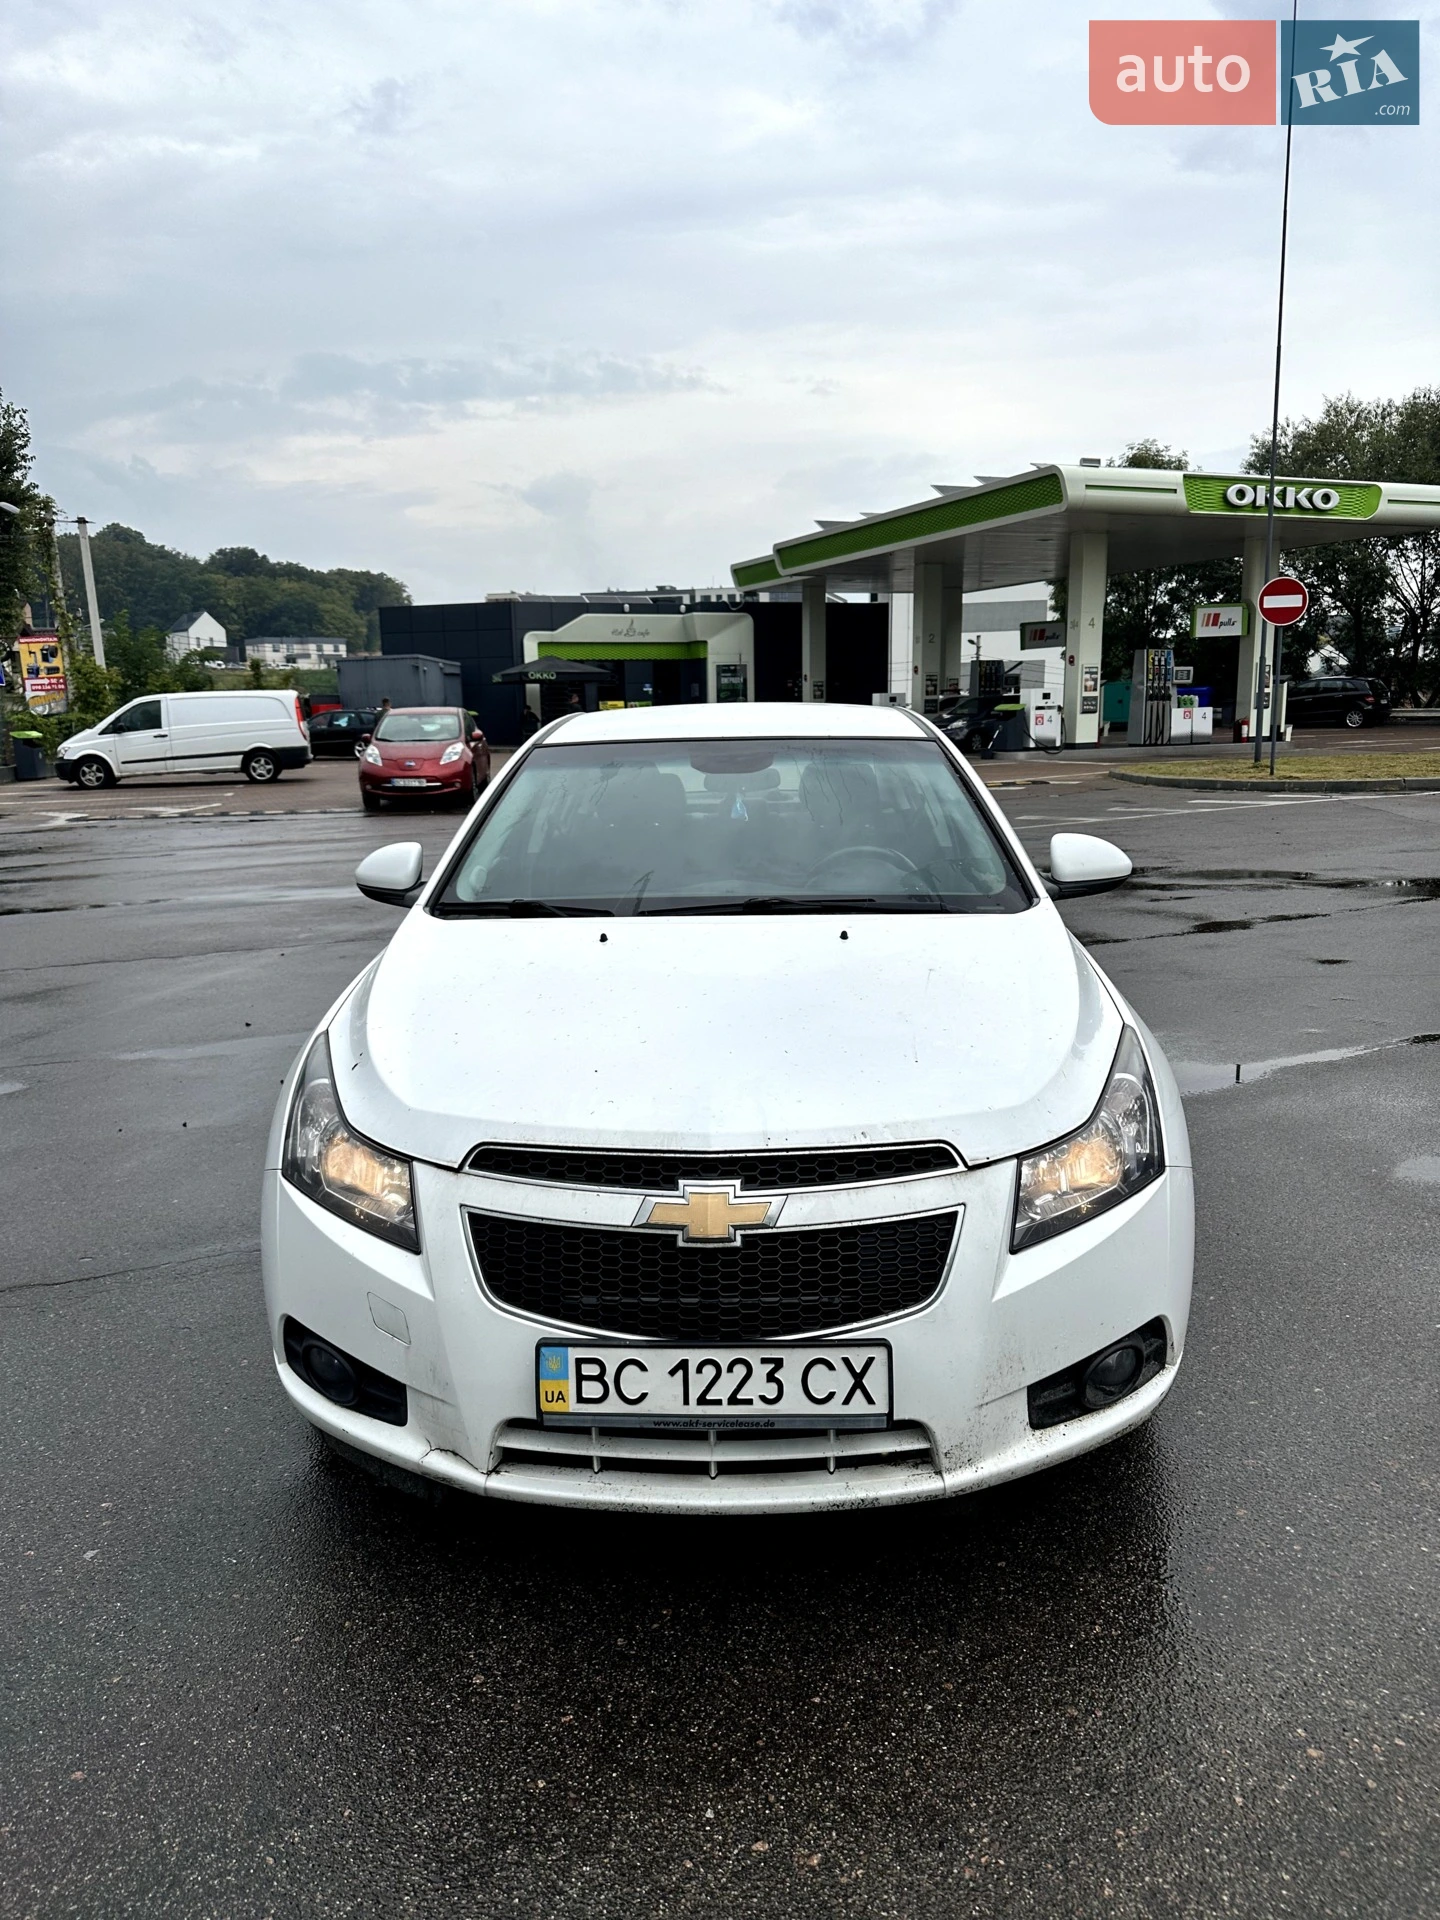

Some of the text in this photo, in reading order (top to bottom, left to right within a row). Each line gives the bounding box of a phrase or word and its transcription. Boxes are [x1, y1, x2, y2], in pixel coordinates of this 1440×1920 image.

[1226, 484, 1340, 511] OKKO
[1088, 617, 1096, 629] 4
[928, 633, 936, 644] 2
[528, 671, 557, 680] OKKO
[575, 1356, 876, 1406] BC 1223 CX
[545, 1390, 566, 1403] UA
[653, 1419, 776, 1428] www.akf-servicelease.de
